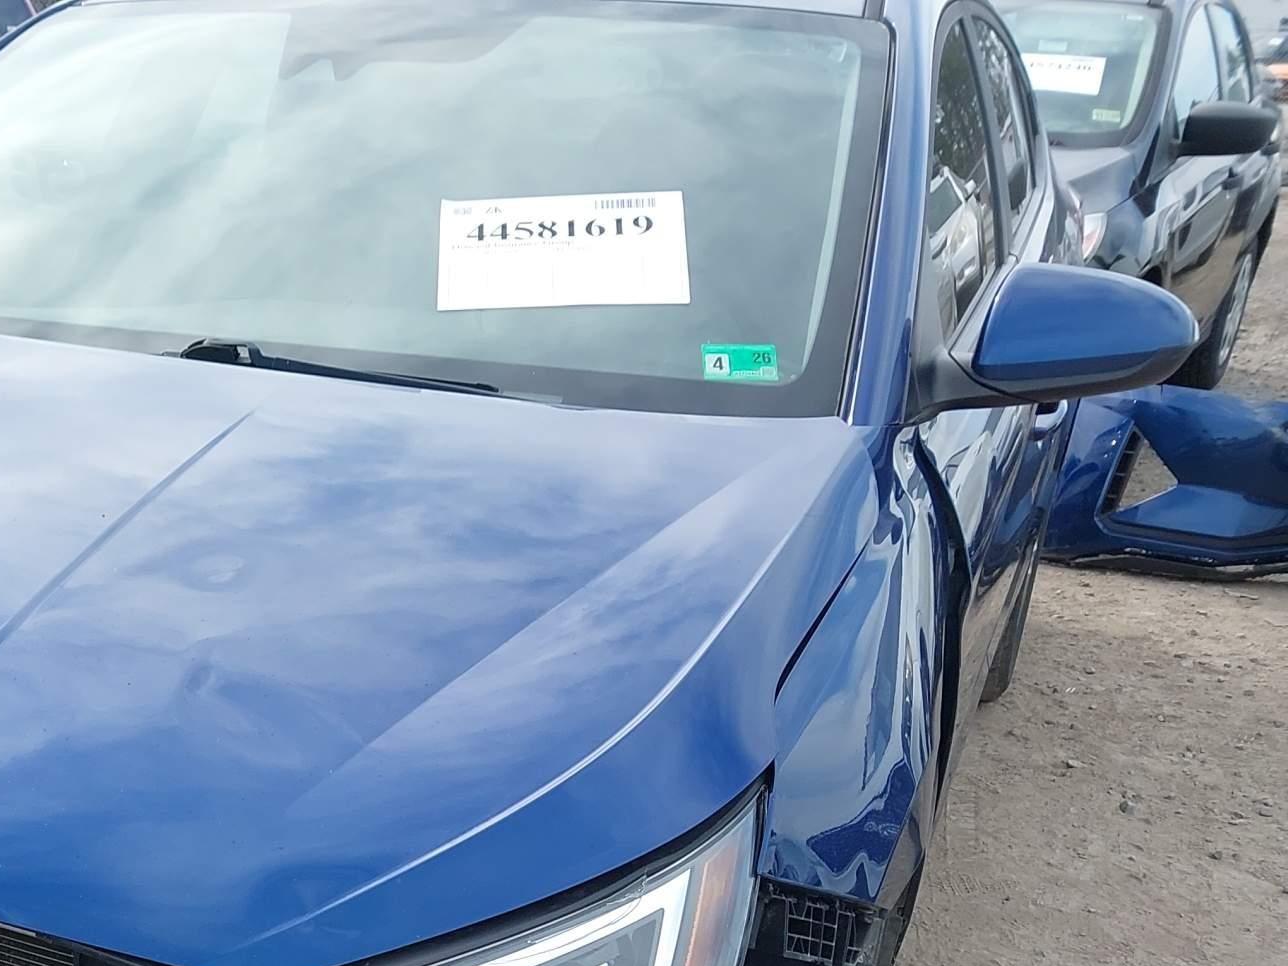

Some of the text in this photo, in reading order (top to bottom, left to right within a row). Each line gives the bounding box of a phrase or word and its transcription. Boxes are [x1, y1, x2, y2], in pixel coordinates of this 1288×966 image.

[466, 215, 654, 241] 44581619
[713, 351, 772, 371] 4 26
